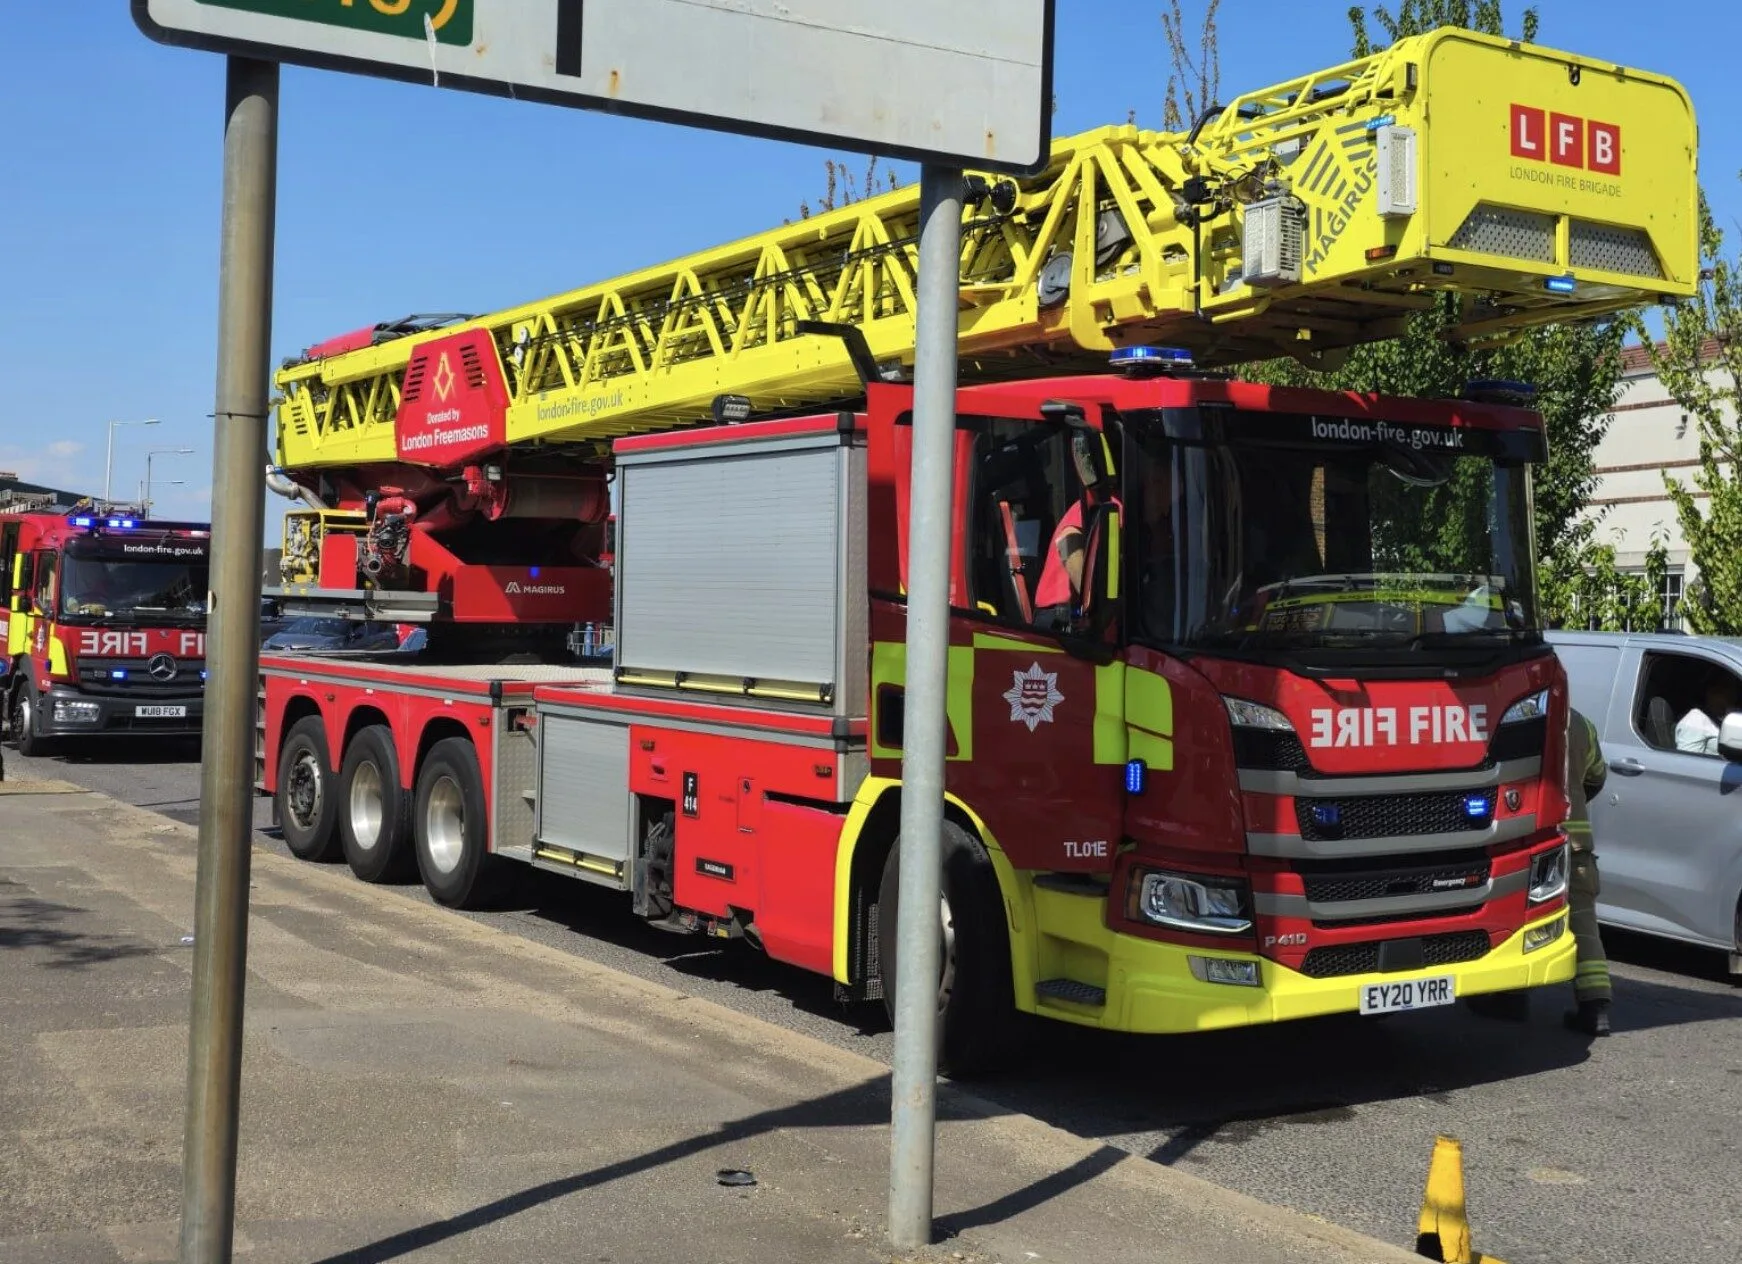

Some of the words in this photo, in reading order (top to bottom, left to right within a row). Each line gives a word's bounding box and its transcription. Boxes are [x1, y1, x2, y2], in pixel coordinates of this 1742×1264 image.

[1509, 165, 1554, 185] LONDON
[1556, 174, 1577, 190] FIRE
[1579, 178, 1622, 198] BRIGADE
[537, 393, 623, 422] london-fire.gov.uk
[427, 409, 451, 425] Donated
[452, 408, 460, 422] by
[401, 432, 433, 451] London
[434, 424, 489, 446] Freemasons
[1312, 416, 1464, 450] london-fire.gov.uk
[124, 544, 203, 556] london-fire.gov.uk
[523, 585, 565, 595] MAGIRUS
[141, 708, 161, 716] WU18
[163, 708, 181, 716] FGX
[1409, 704, 1489, 744] FIRE
[688, 777, 694, 792] F
[684, 795, 697, 811] 414
[1063, 841, 1108, 858] TL01E
[1264, 935, 1276, 948] P
[1368, 983, 1413, 1009] EY20
[1417, 979, 1448, 1003] YRR
